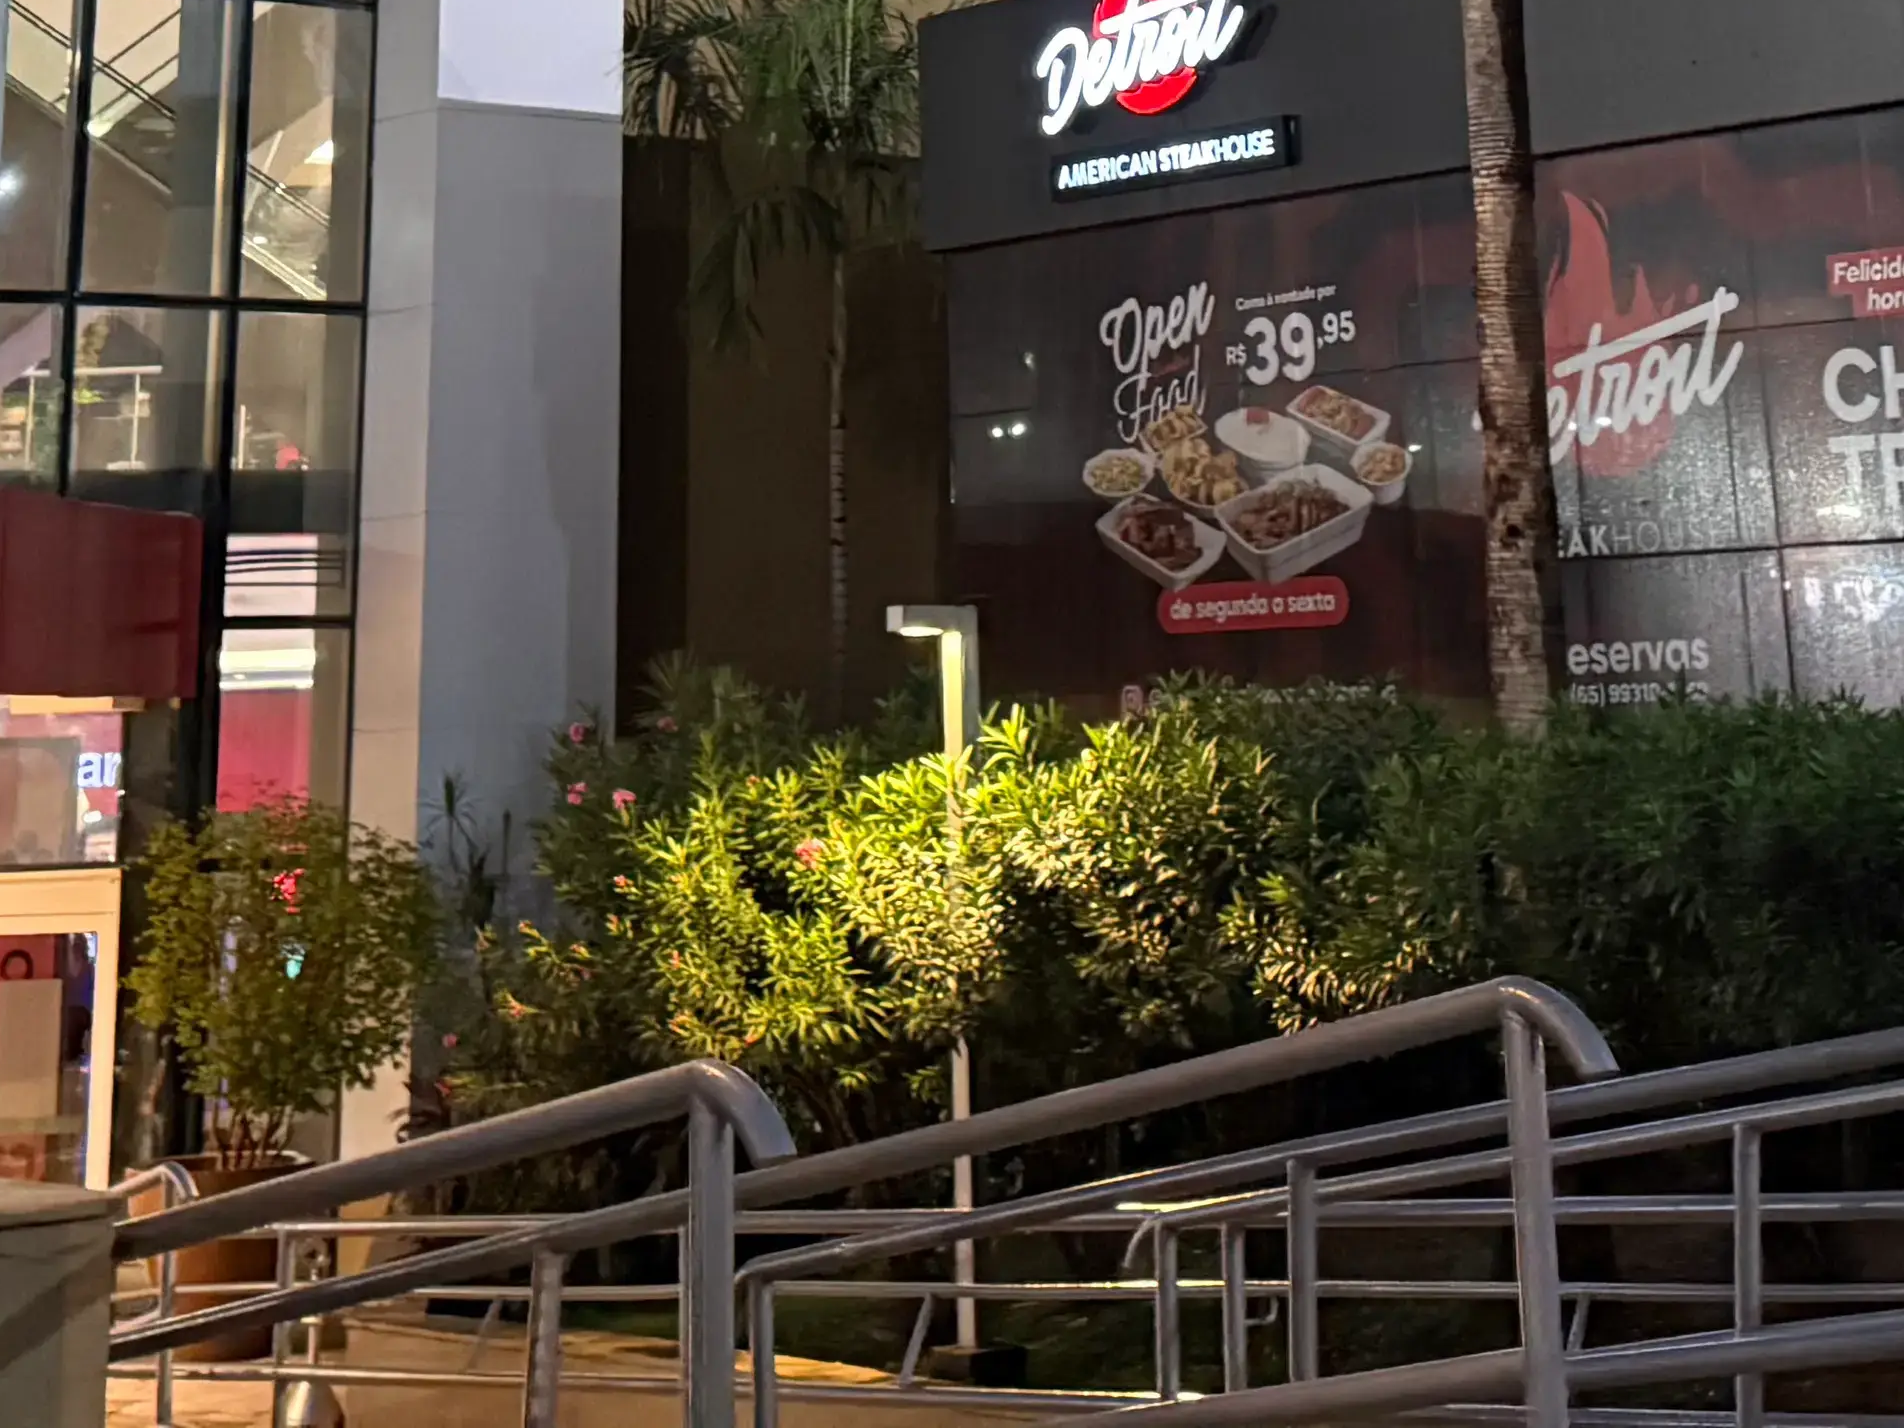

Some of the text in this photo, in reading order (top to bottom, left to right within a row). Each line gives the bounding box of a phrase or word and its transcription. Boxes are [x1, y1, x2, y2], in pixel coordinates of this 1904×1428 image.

[1058, 129, 1276, 189] AMERICAN STEAKHOUSE
[1099, 281, 1215, 393] Open
[1226, 343, 1246, 367] R$
[1113, 344, 1207, 443] Food
[1170, 598, 1193, 620] de
[1567, 638, 1710, 675] eservas
